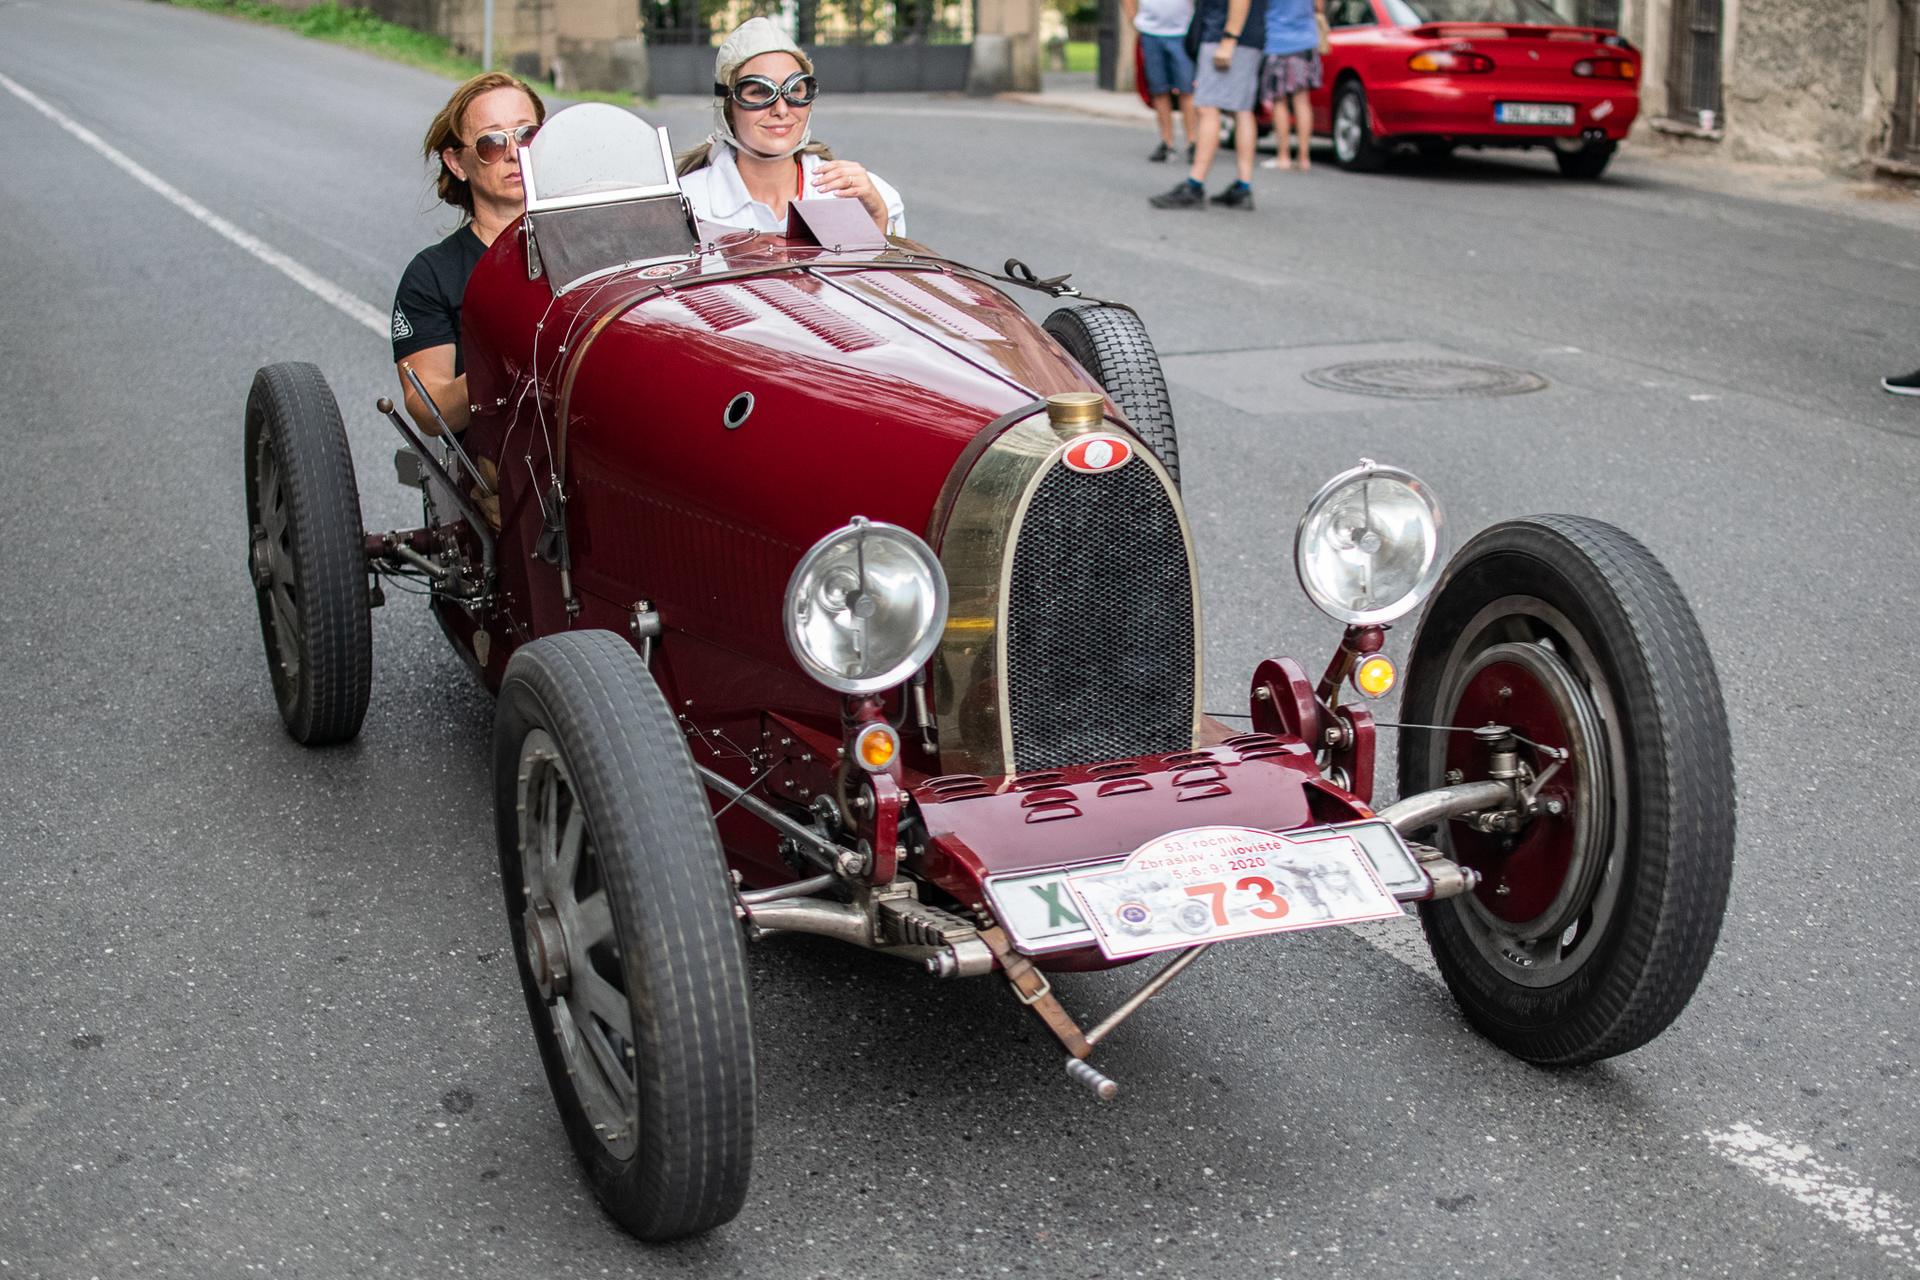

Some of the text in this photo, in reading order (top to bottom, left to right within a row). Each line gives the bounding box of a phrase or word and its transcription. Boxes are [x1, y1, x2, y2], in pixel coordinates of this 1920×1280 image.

[1138, 852, 1204, 870] Zbraslav
[1228, 857, 1266, 871] 2020
[1184, 876, 1289, 926] 73
